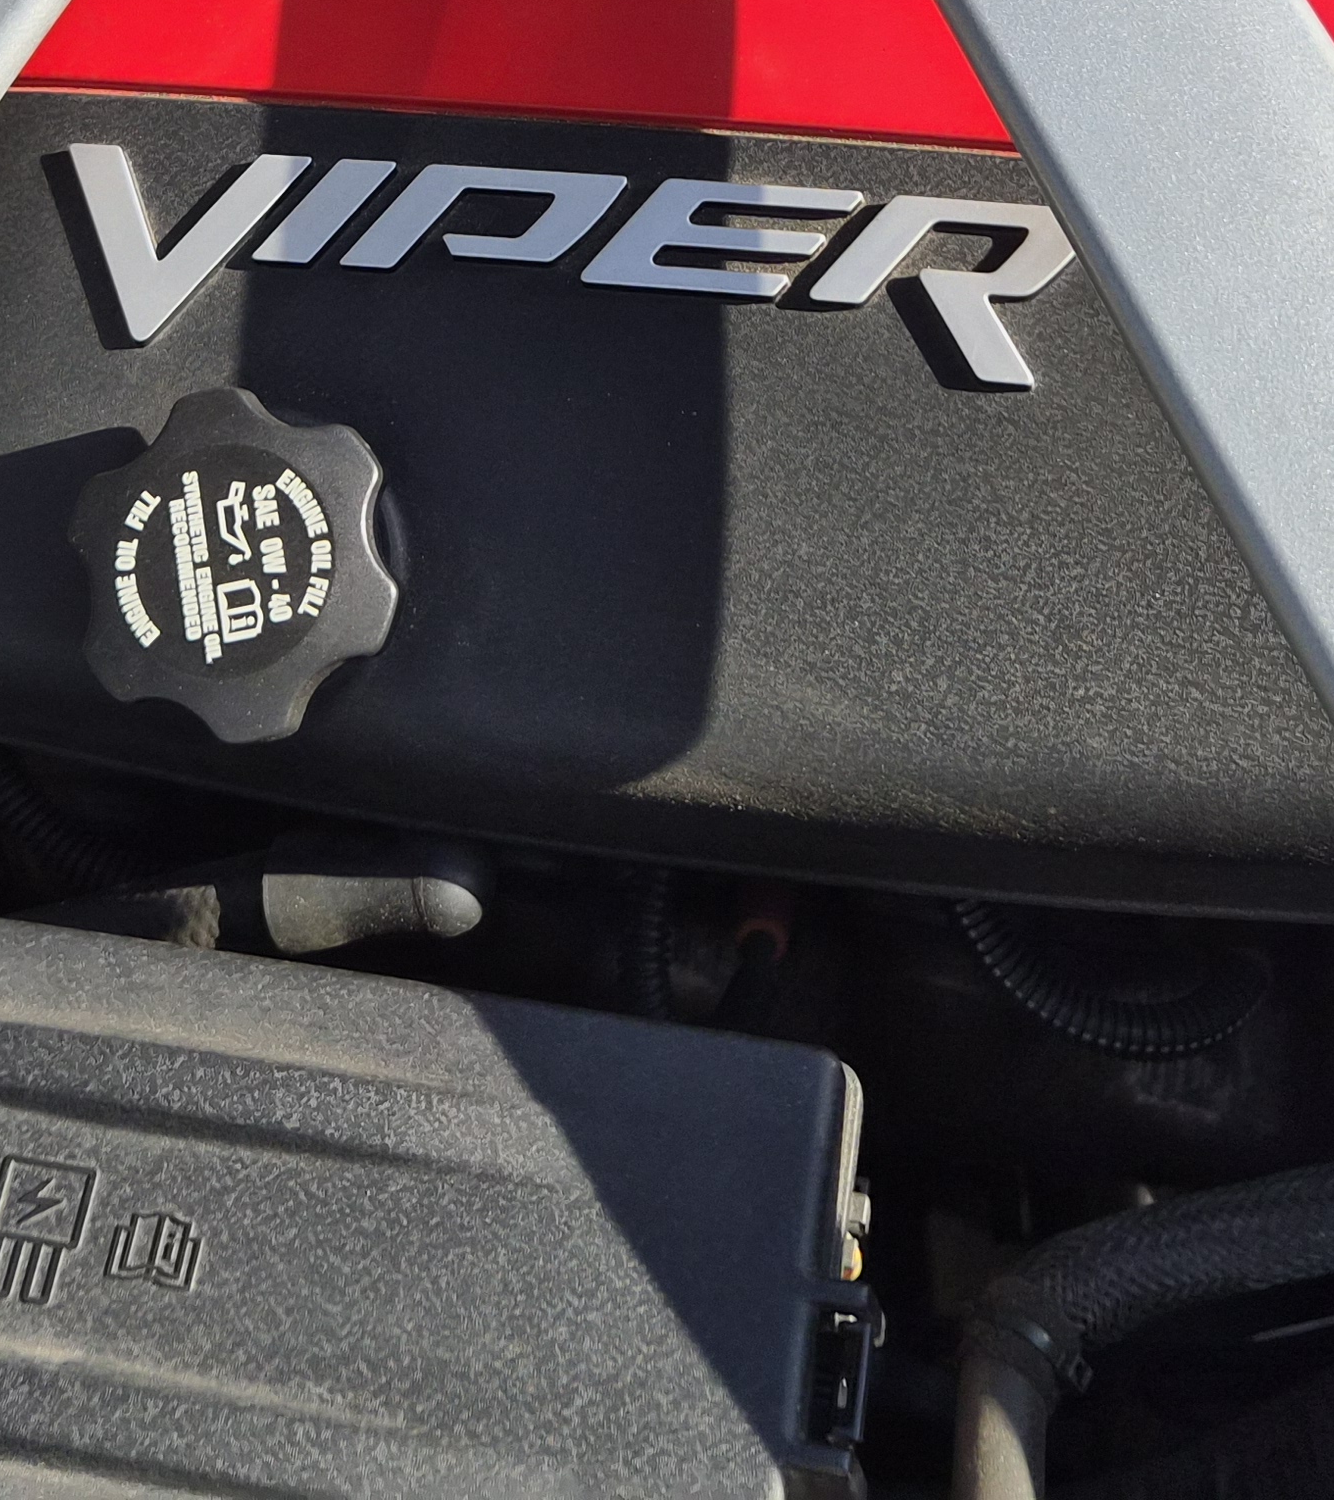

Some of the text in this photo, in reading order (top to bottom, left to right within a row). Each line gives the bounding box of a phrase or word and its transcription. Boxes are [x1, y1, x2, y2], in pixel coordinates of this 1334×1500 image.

[69, 142, 1075, 390] VIPER
[114, 490, 162, 648] ENGINE OIL FILL
[169, 498, 202, 642] RECOMMENDED
[182, 470, 223, 665] SYNTHETIC ENGINE OIL
[252, 484, 280, 530] SAE
[275, 468, 332, 617] ENGINE OIL FILL
